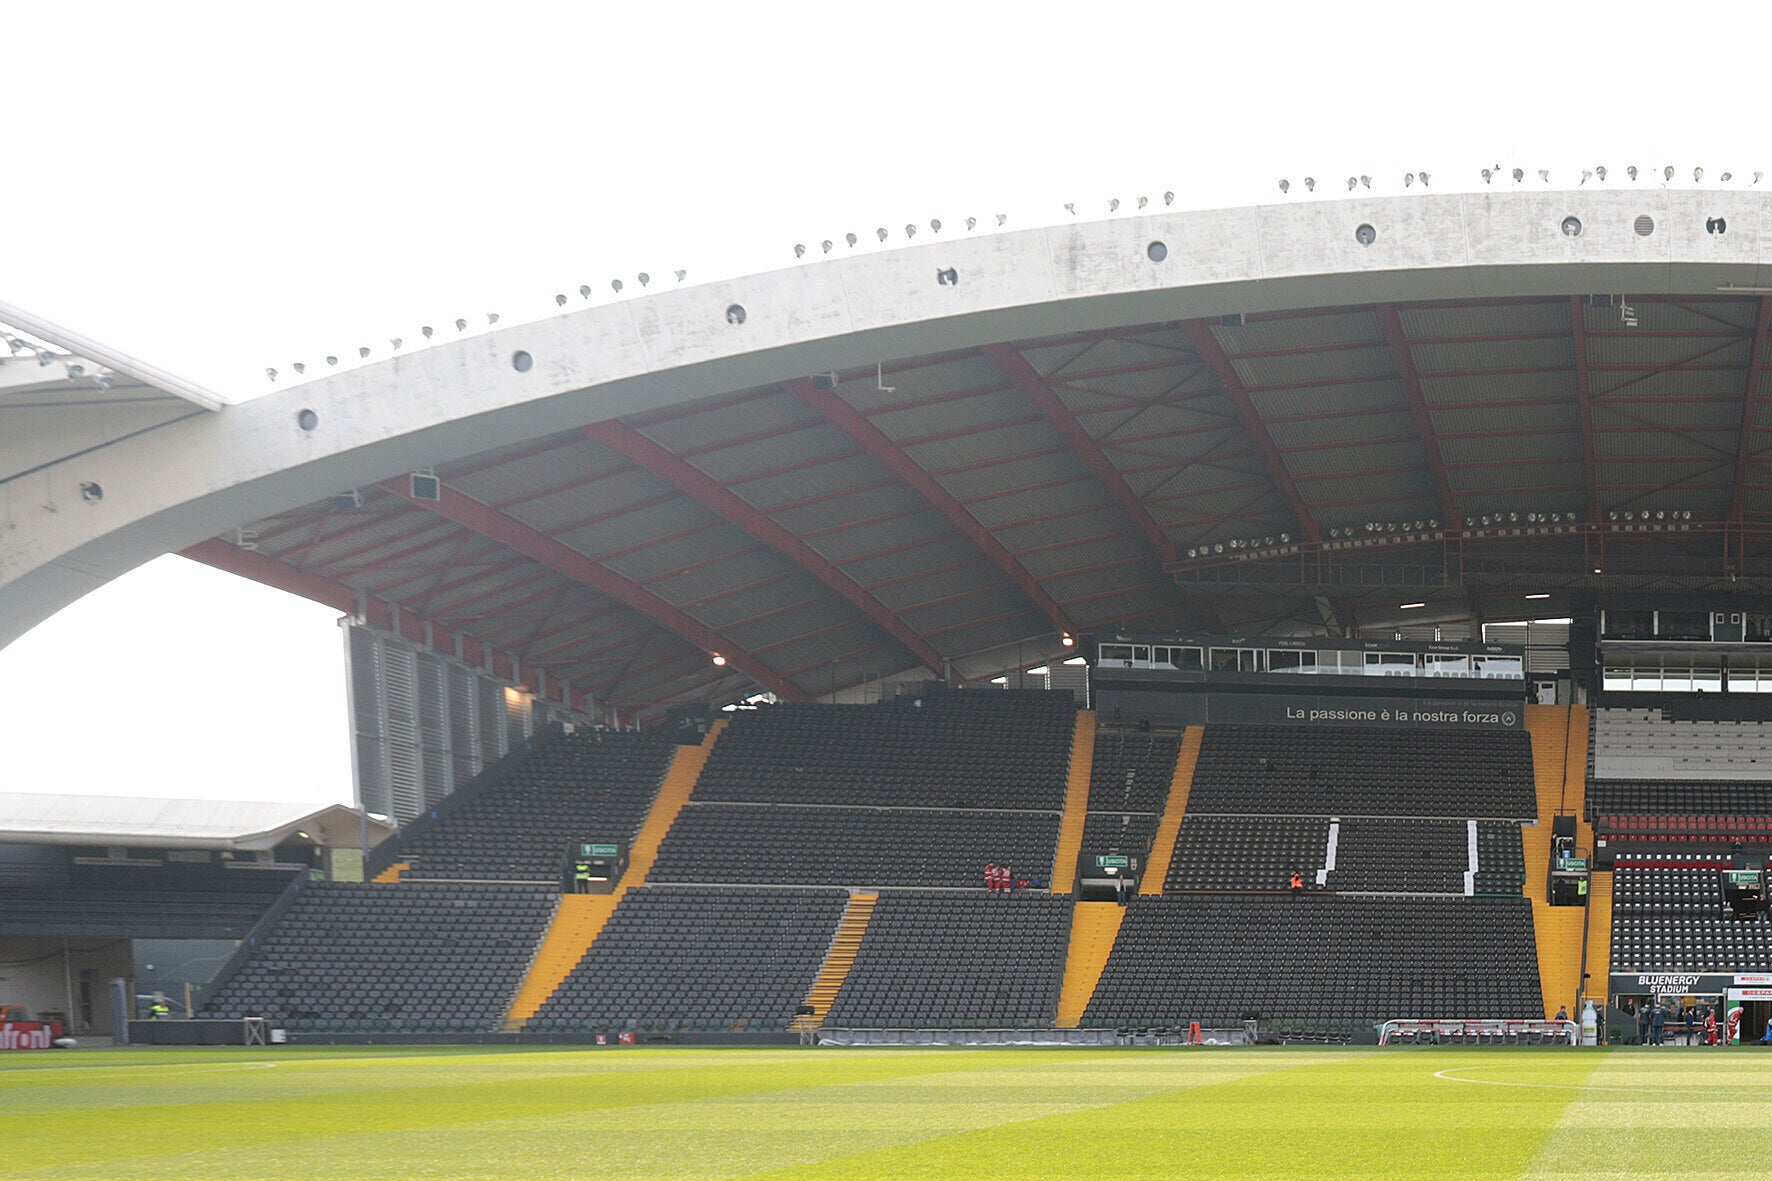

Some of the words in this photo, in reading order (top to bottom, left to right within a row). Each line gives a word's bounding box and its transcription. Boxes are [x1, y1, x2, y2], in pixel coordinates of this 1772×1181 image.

[1287, 707, 1305, 719] La
[1311, 708, 1376, 721] passione
[1381, 709, 1390, 721] è
[1396, 710, 1408, 721] la
[1413, 711, 1458, 722] nostra
[1462, 711, 1499, 723] forza
[1638, 976, 1700, 985] BLUENERGY
[1650, 985, 1689, 993] STADIUM
